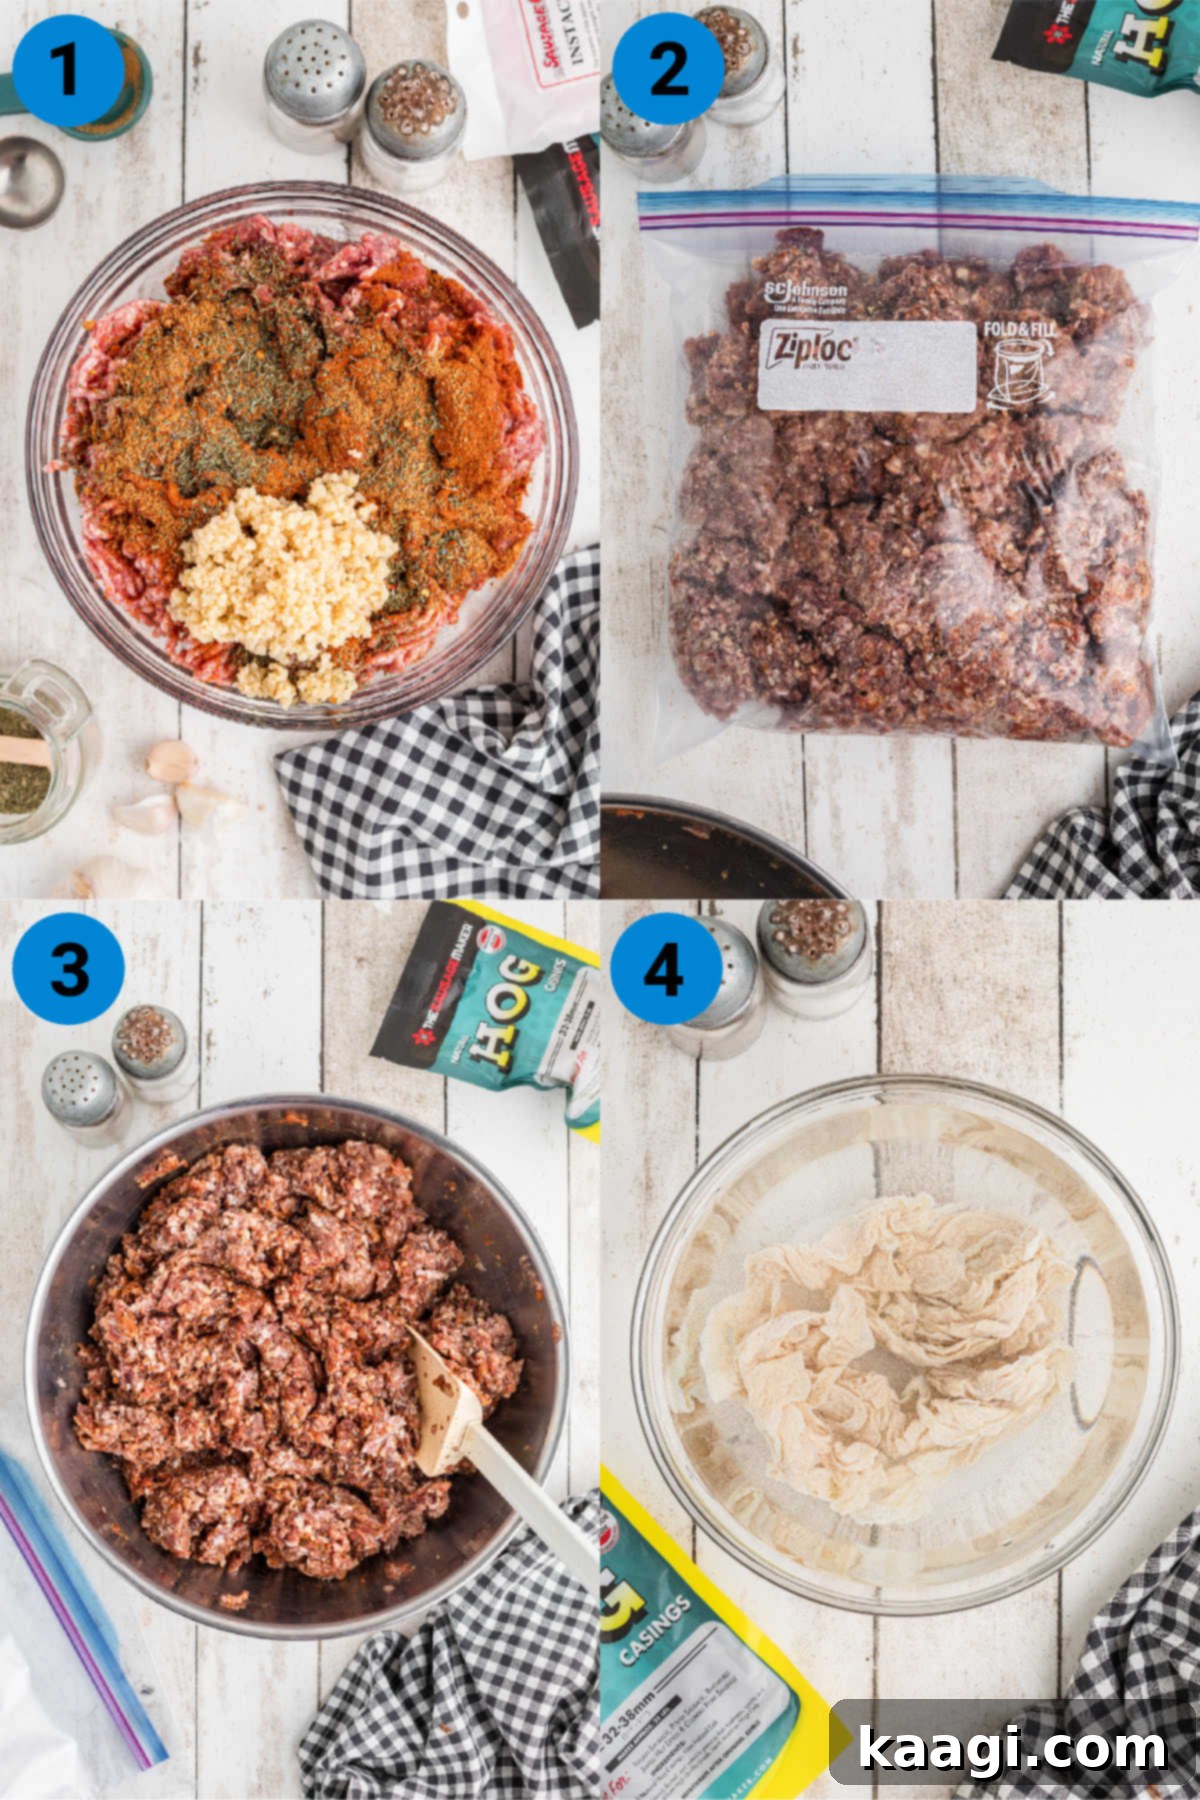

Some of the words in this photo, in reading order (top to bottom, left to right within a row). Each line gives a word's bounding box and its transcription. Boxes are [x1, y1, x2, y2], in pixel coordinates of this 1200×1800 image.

[468, 954, 543, 1072] HOG
[619, 1595, 692, 1667] CASINGS
[602, 1691, 656, 1746] 32-38mm
